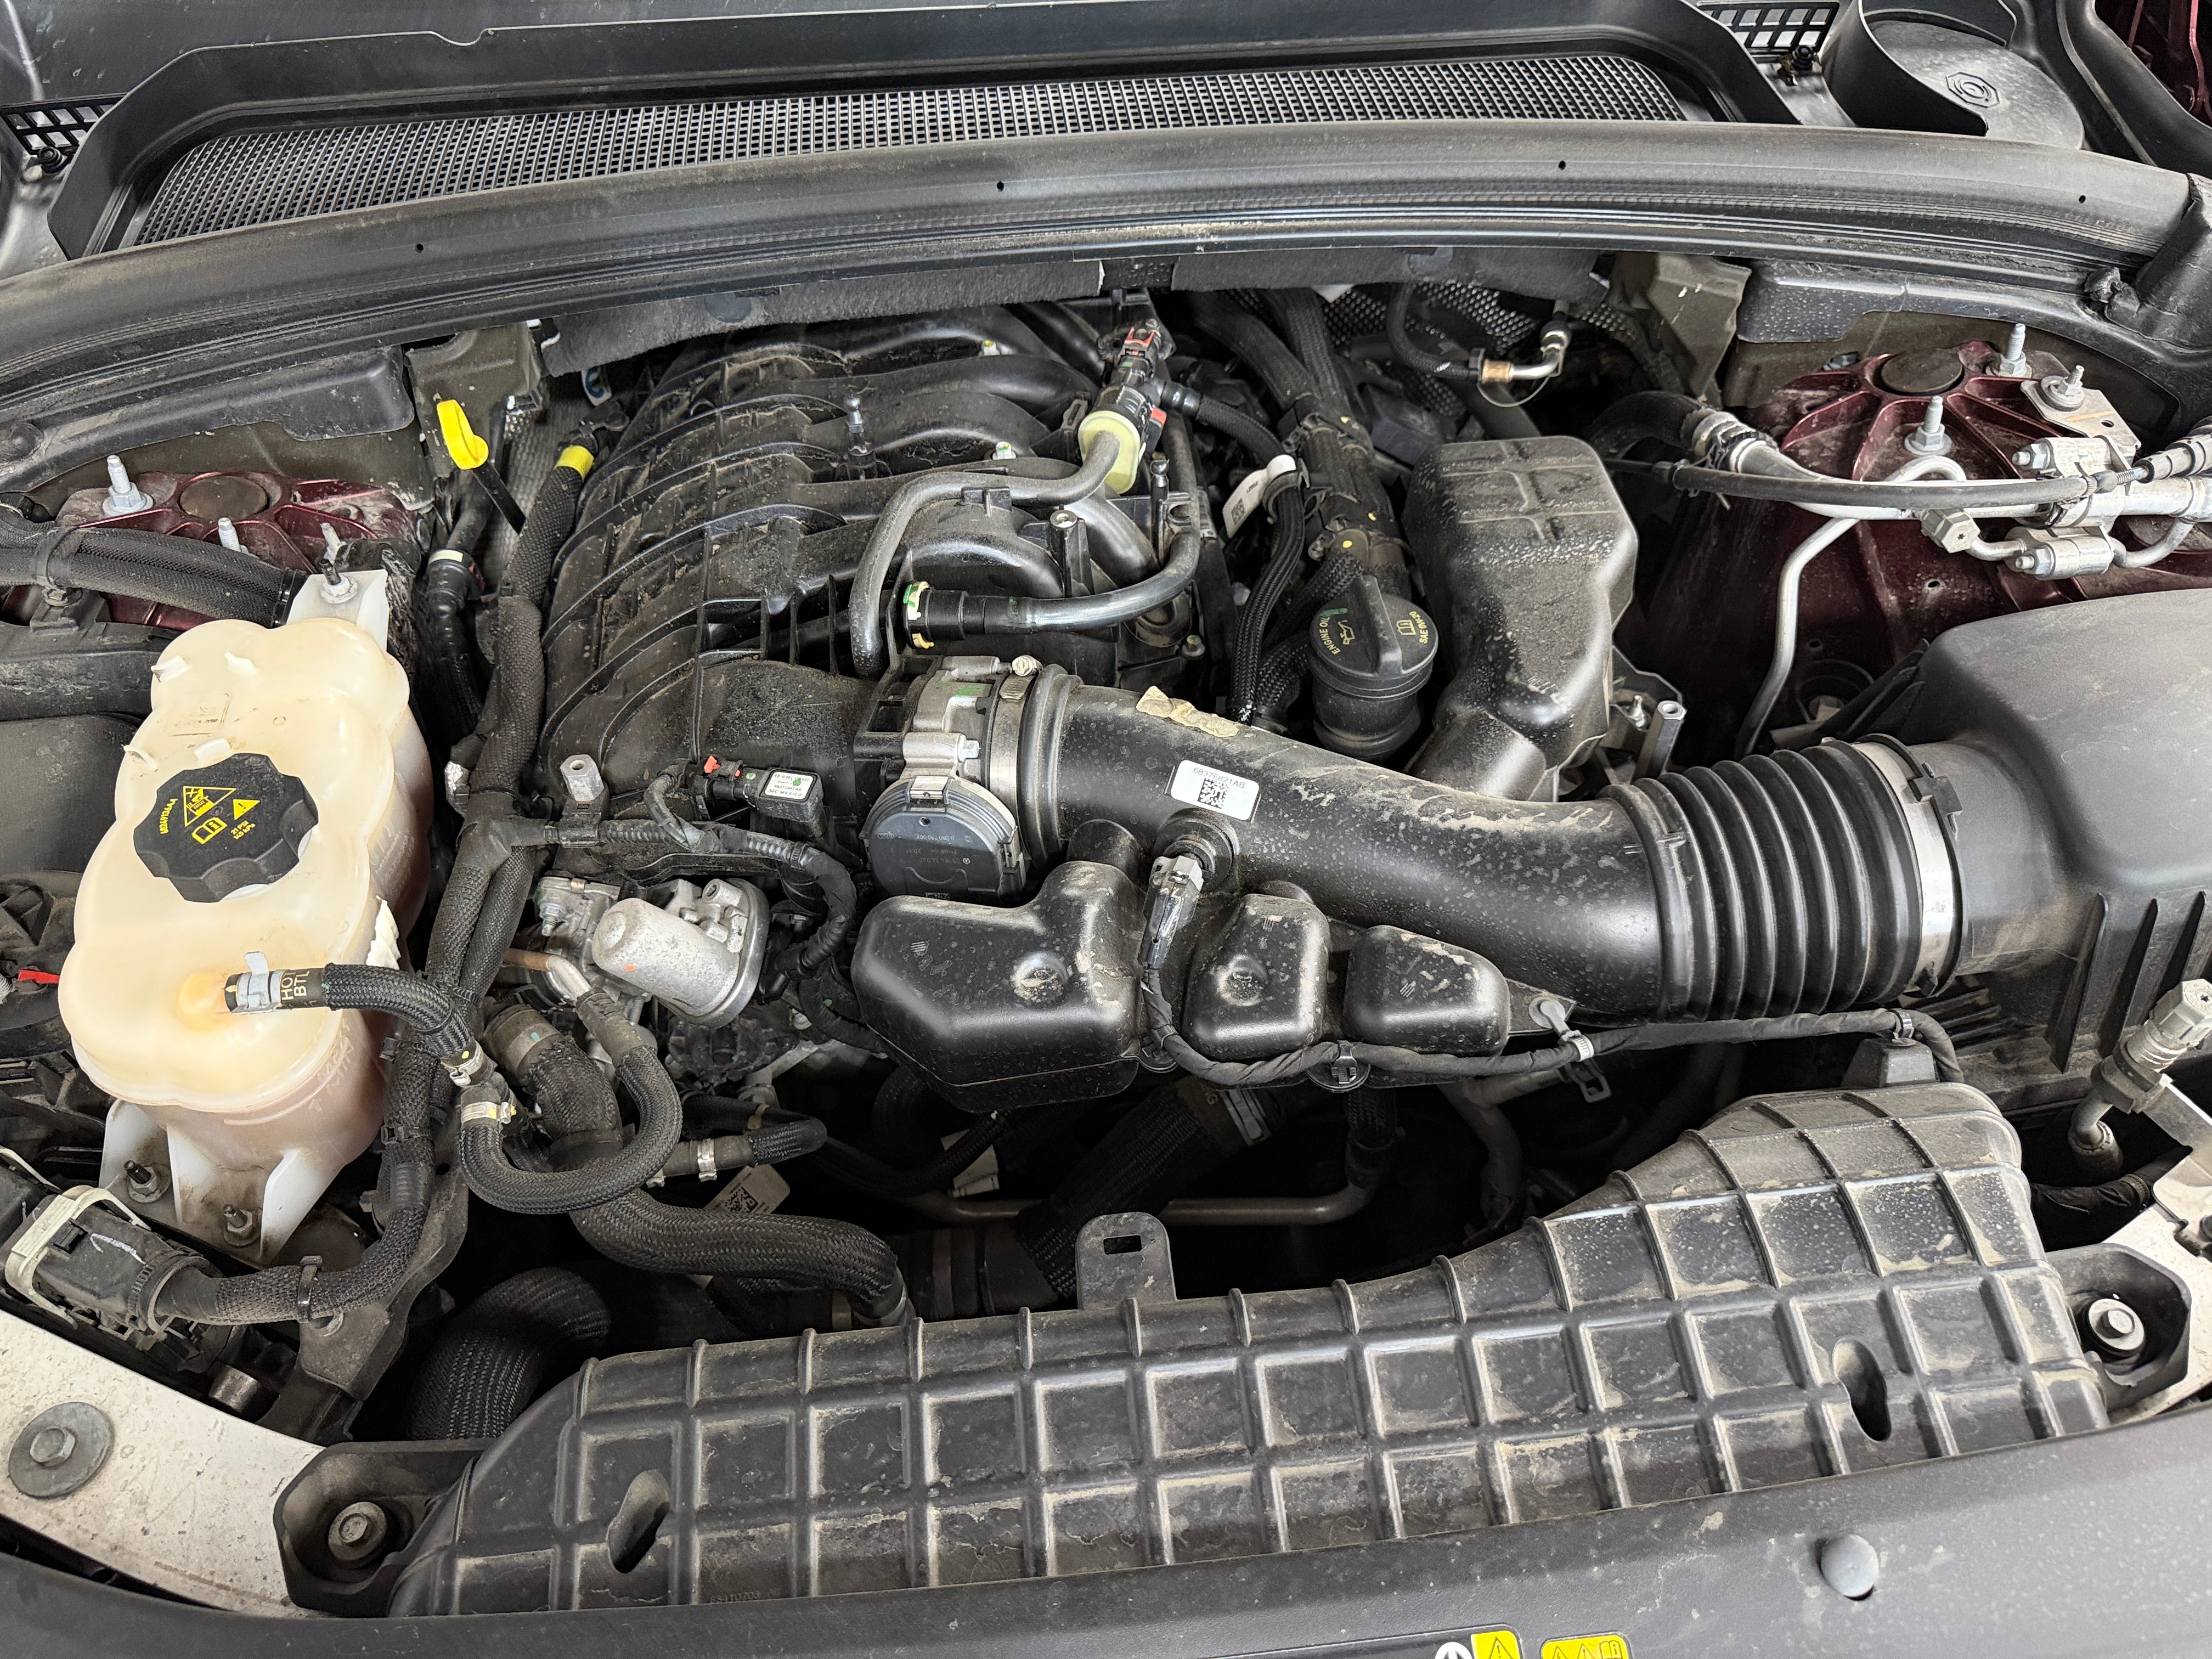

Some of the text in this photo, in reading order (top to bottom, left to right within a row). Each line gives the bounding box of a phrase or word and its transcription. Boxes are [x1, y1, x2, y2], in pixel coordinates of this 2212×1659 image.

[1319, 616, 1341, 654] ENGINE OIL
[1409, 611, 1429, 644] SAE 0W-20
[1193, 767, 1245, 789] 68376821AB
[237, 820, 250, 830] PSI
[294, 970, 311, 997] BTL
